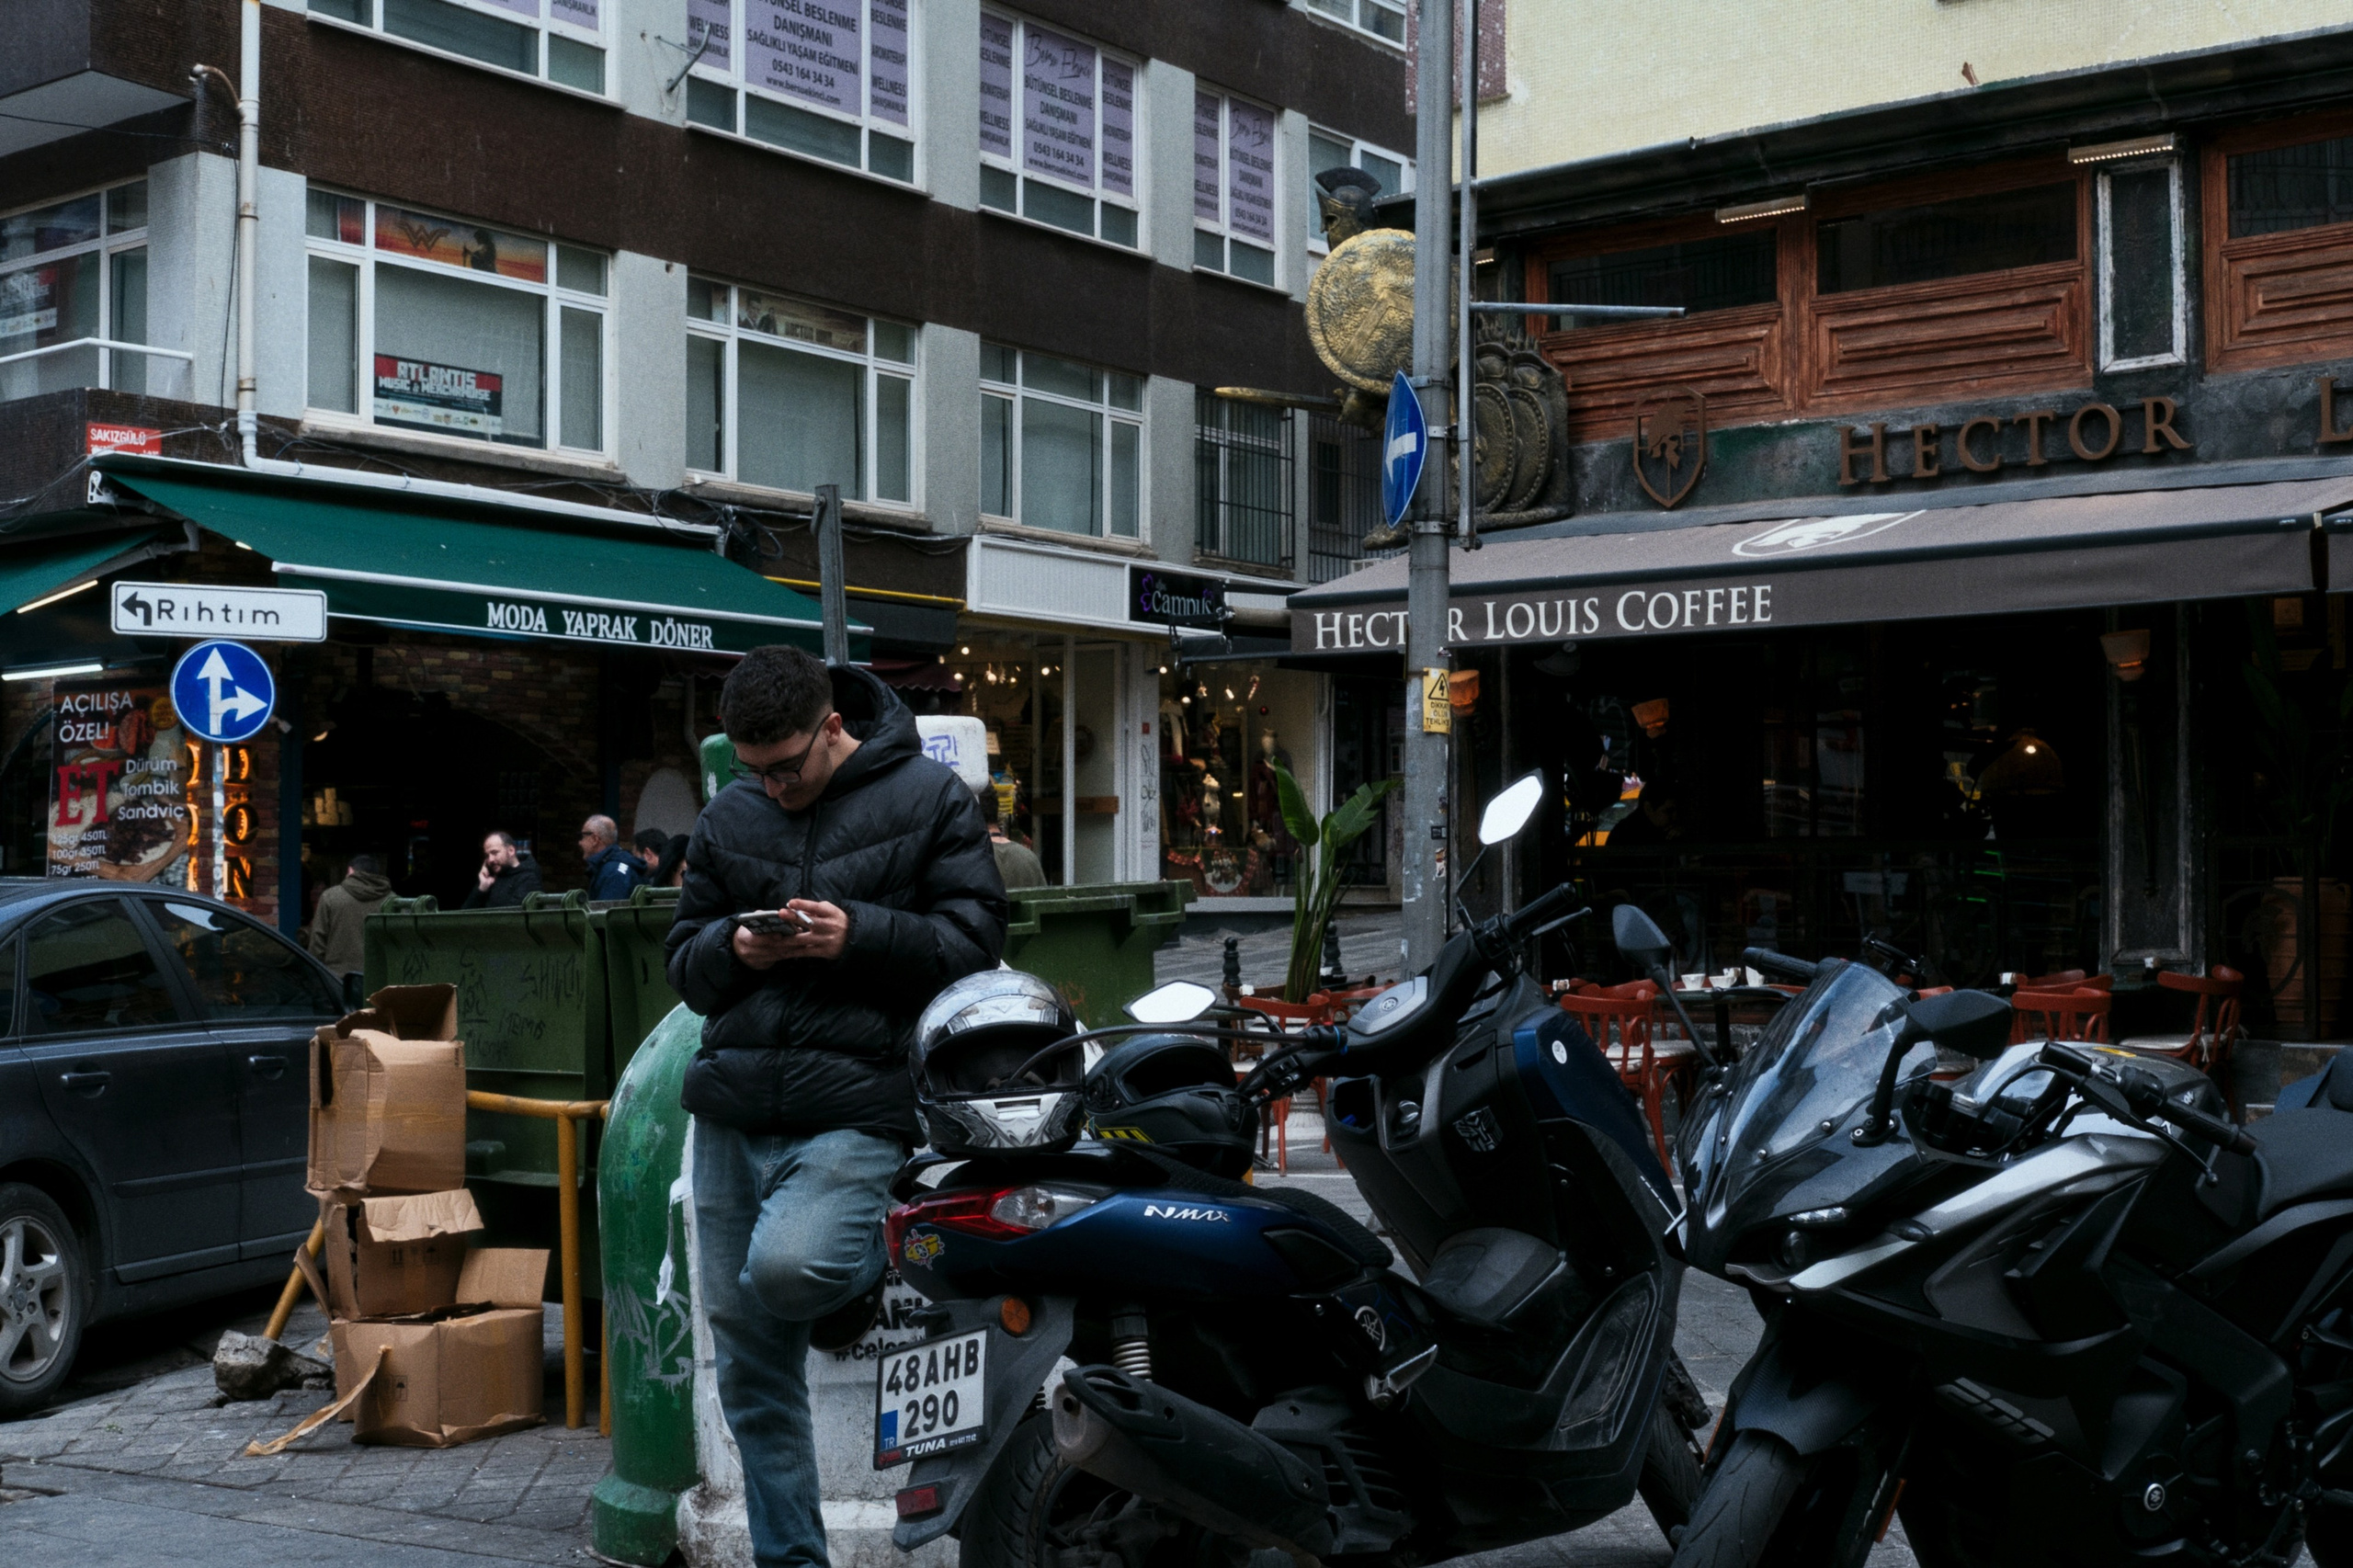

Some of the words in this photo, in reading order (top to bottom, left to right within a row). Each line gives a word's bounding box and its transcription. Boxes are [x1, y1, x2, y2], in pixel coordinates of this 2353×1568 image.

[688, 15, 728, 40] WELNESS
[804, 2, 857, 33] BESLENME
[870, 7, 906, 33] BESLENME
[774, 15, 832, 47] DANIŞMANI
[747, 28, 786, 52] SAĞLIKLI
[787, 41, 817, 66] YAŞAM
[818, 50, 858, 76] EĞİTMENİ
[772, 59, 793, 75] 0543
[796, 65, 811, 80] 164
[812, 71, 823, 85] 34
[824, 74, 835, 88] 34
[871, 75, 905, 97] WELLNESS
[1059, 86, 1093, 109] BESLENME
[1033, 141, 1051, 157] 0543
[1052, 145, 1064, 160] 164
[1065, 150, 1074, 164] 34
[1075, 153, 1084, 167] 34
[378, 375, 411, 392] MUSIC
[397, 359, 476, 387] ATLANTIS
[90, 427, 145, 446] SAKIZGÜLÜ
[1838, 396, 2194, 486] HECTOR
[487, 602, 549, 632] MODA
[562, 610, 638, 642] YAPRAK
[650, 618, 714, 649] DÖNER
[1313, 607, 1469, 650] HECTR
[1483, 597, 1599, 641] LOUIS
[1616, 585, 1772, 631] COFFEE
[60, 691, 133, 718] AÇILIŞA
[59, 721, 109, 743] ÖZEL!
[125, 758, 178, 774] Dürüm
[54, 760, 120, 827] ET
[122, 779, 180, 797] Tombik
[117, 802, 185, 822] Sandviç
[81, 829, 108, 842] 450TL
[52, 848, 78, 860] 100gr
[51, 864, 72, 876] 75gr
[74, 859, 100, 873] 250TL
[885, 1338, 980, 1396] 48AHB
[904, 1389, 959, 1439] 290
[884, 1436, 895, 1449] TR
[905, 1437, 947, 1458] TUNA
